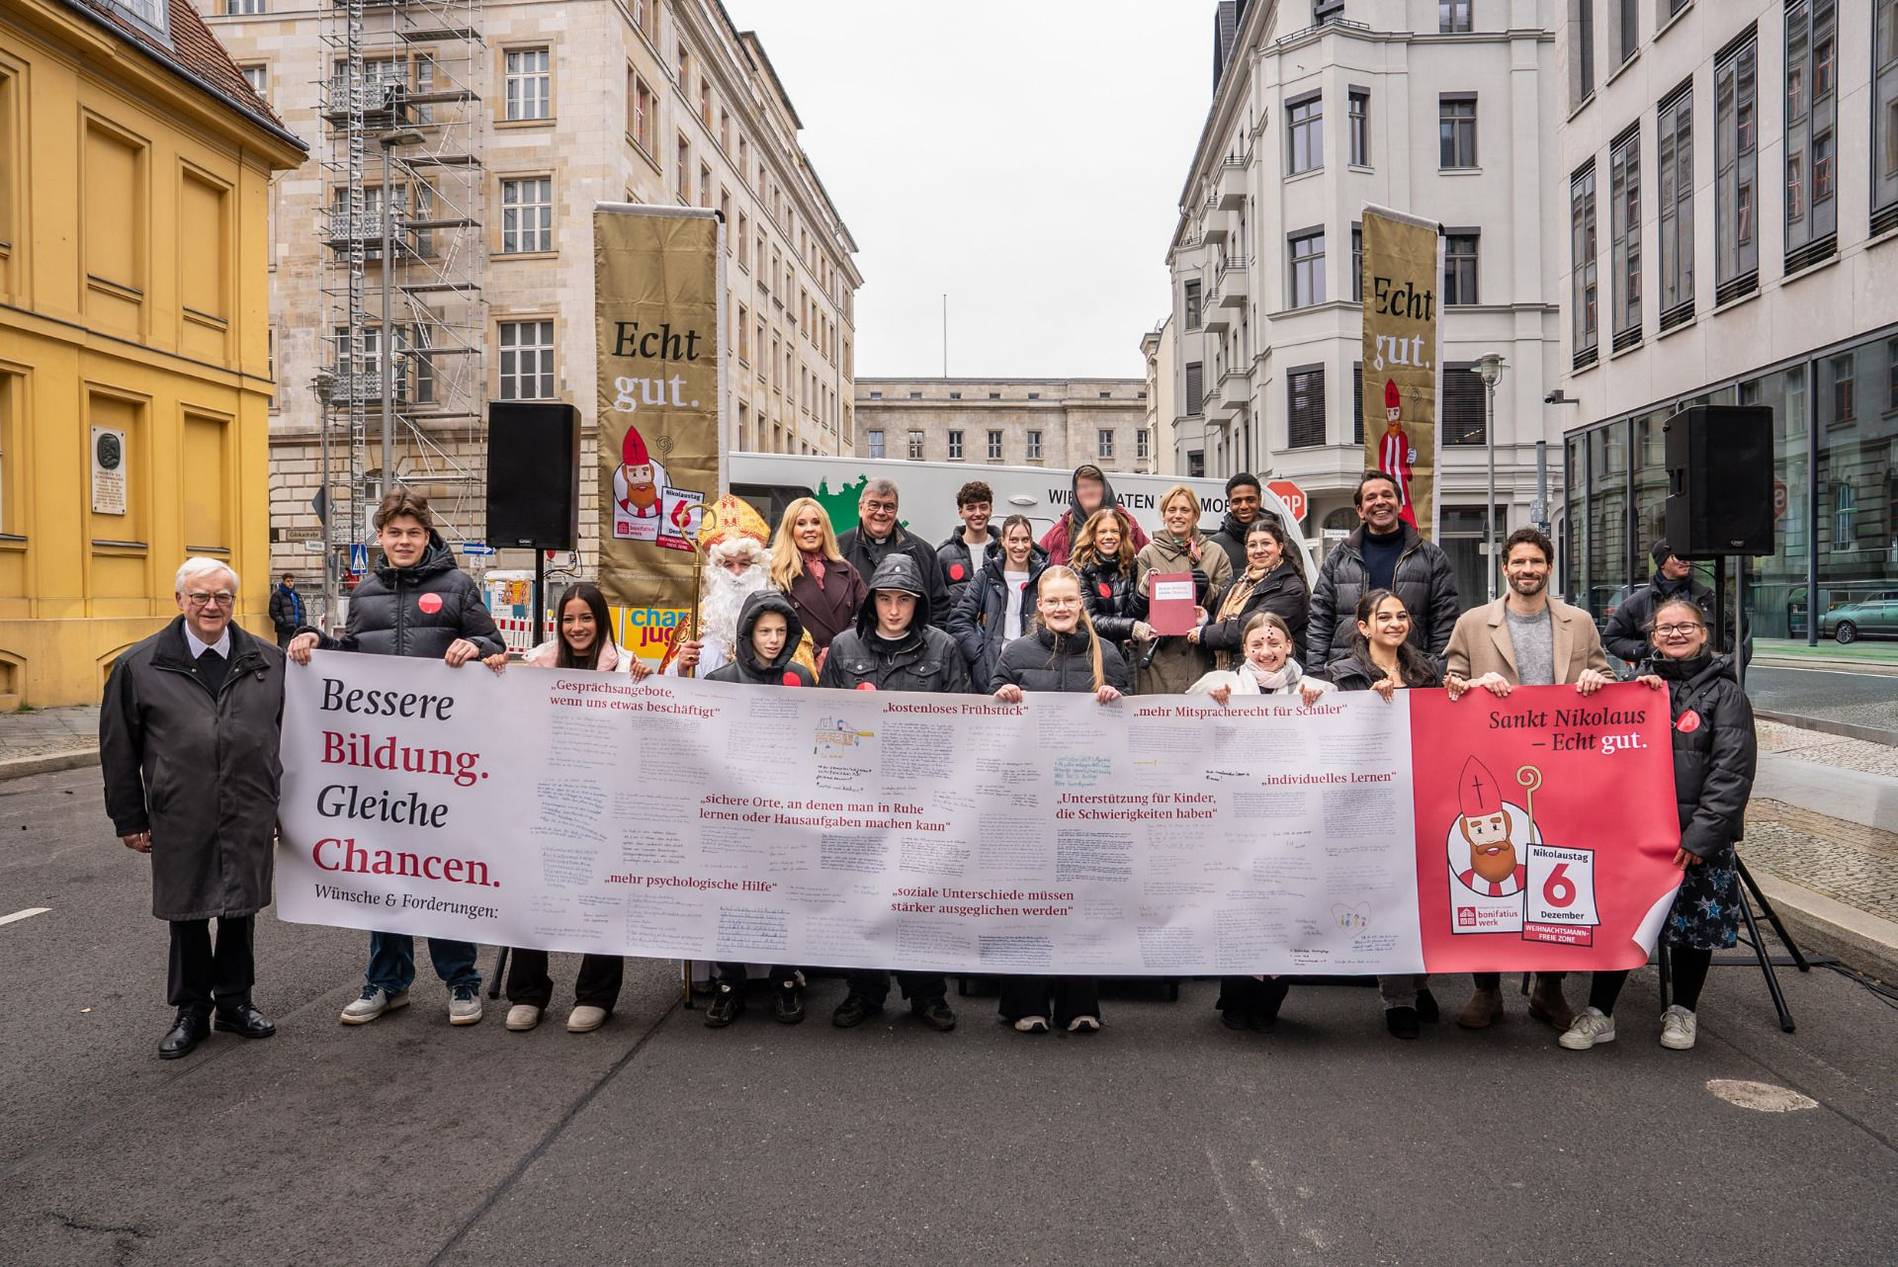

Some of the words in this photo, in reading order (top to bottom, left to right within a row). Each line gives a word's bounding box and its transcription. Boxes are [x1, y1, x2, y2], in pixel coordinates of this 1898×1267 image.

[1374, 277, 1434, 322] Echt
[612, 321, 702, 361] Echt
[613, 374, 699, 412] gut.
[671, 499, 691, 528] 6
[1282, 495, 1302, 514] OP
[320, 677, 455, 720] Bessere
[550, 696, 582, 707] wenn
[586, 699, 607, 708] uns
[610, 700, 643, 711] etwas
[647, 701, 720, 719] beschäftigt“
[883, 702, 958, 714] „kostenloses
[962, 704, 1029, 716] Frühstück“
[1134, 706, 1172, 718] „mehr
[1175, 707, 1269, 720] Mitspracherecht
[1273, 706, 1293, 717] für
[1295, 704, 1348, 716] Schüler“
[1489, 710, 1548, 729] Sankt
[1554, 707, 1646, 728] Nikolaus
[1552, 732, 1597, 752] Echt
[1601, 731, 1648, 755] gut.
[321, 730, 489, 787] Bildung.
[1261, 773, 1347, 786] „individuelles
[1351, 771, 1397, 783] Lernen“
[316, 784, 449, 828] Gleiche
[700, 793, 749, 807] „sichere
[752, 797, 784, 809] Orte,
[787, 801, 802, 809] an
[806, 800, 843, 811] denen
[848, 803, 874, 812] man
[878, 802, 890, 813] in
[894, 803, 924, 815] Ruhe
[1057, 793, 1149, 806] „Unterstützung
[1152, 792, 1170, 803] für
[1173, 792, 1217, 804] Kinder,
[699, 808, 738, 821] lernen
[742, 812, 771, 823] oder
[774, 814, 861, 828] Hausaufgaben
[865, 818, 912, 830] machen
[916, 820, 951, 832] kann“
[1055, 808, 1075, 819] die
[1078, 808, 1173, 822] Schwierigkeiten
[1175, 808, 1218, 819] haben“
[312, 838, 501, 888] Chancen.
[1533, 848, 1589, 863] Nikolaustag
[604, 873, 643, 884] „mehr
[646, 875, 738, 890] psychologische
[742, 880, 777, 892] Hilfe“
[1543, 863, 1576, 908] 6
[314, 884, 380, 905] Wünsche
[385, 893, 397, 907] &
[401, 893, 499, 920] Forderungen:
[892, 886, 939, 898] „soziale
[942, 888, 1024, 900] Unterschiede
[1028, 889, 1074, 900] müssen
[891, 902, 935, 913] stärker
[938, 903, 1019, 917] ausgeglichen
[1022, 904, 1074, 916] werden“
[1478, 909, 1518, 919] bonifatius
[1541, 910, 1585, 920] Dezember
[1478, 918, 1499, 926] werk
[1525, 925, 1590, 937] WEIHNACHTSMANN-
[1539, 933, 1557, 941] FREIE
